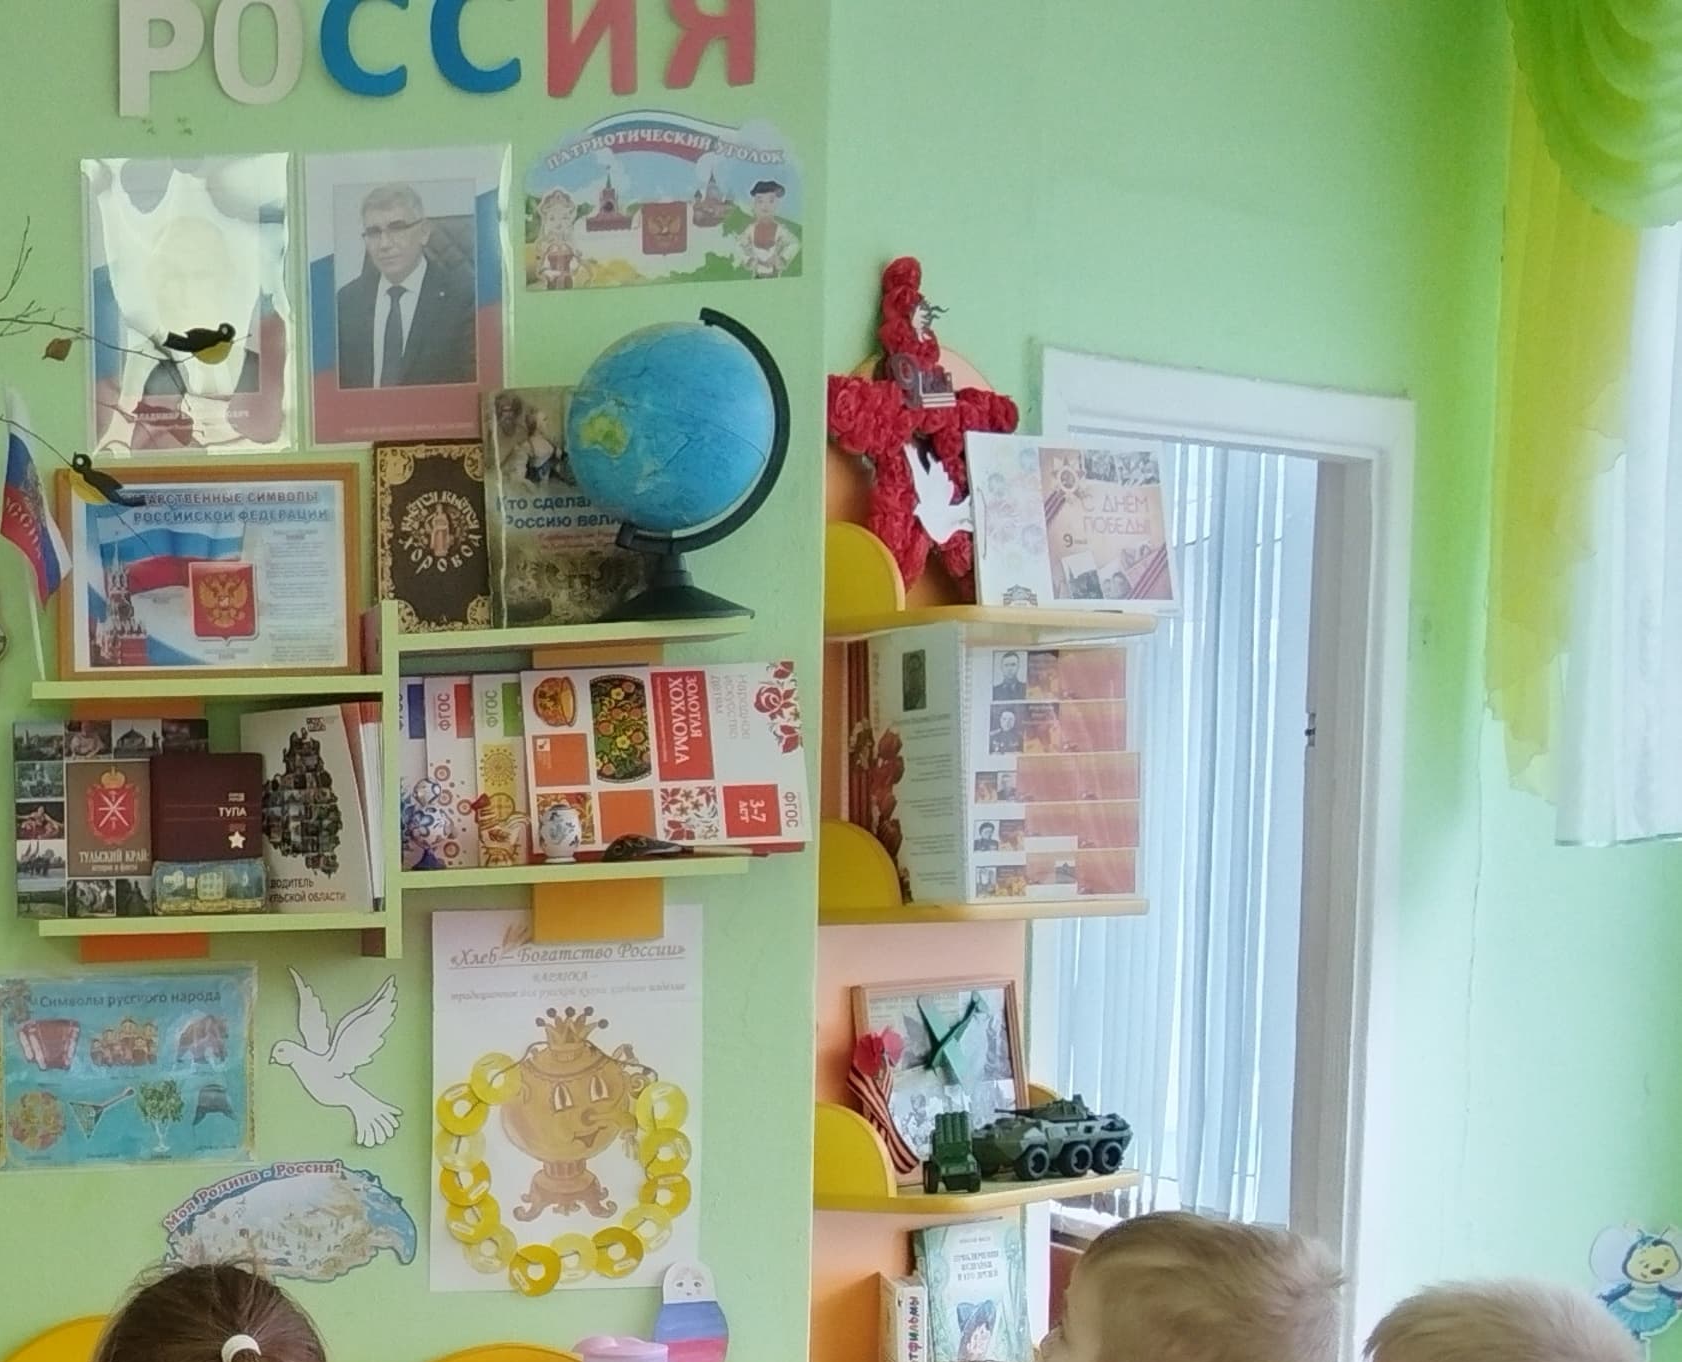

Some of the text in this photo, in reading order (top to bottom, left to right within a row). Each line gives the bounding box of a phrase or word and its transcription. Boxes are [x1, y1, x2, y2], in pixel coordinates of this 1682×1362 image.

[119, 0, 756, 117] РОССИЯ
[547, 128, 784, 170] ПАТРИОТИЧЕСКИЙ УГОЛОК
[246, 490, 319, 503] СИМВОЛЫ
[238, 508, 328, 522] ФЕДЕРАЦИИ
[1062, 533, 1073, 548] 9
[437, 692, 451, 731] ФГОС
[485, 689, 498, 728] ФГОС
[684, 675, 703, 738] ЗОЛОТАЯ
[668, 676, 690, 765] ХОХЛОМА
[218, 806, 247, 817] ТУЛА
[749, 799, 766, 823] 3-7
[783, 791, 799, 829] ФГОС
[78, 848, 123, 864] ТУЛЬСКИЙ
[270, 877, 315, 890] ВОДИТЕЛЬ
[518, 945, 614, 964] Богатство
[40, 991, 222, 1008] Символы русского народа
[166, 1201, 196, 1230] Моя
[198, 1172, 260, 1203] Родина
[275, 1161, 342, 1177] Россия!
